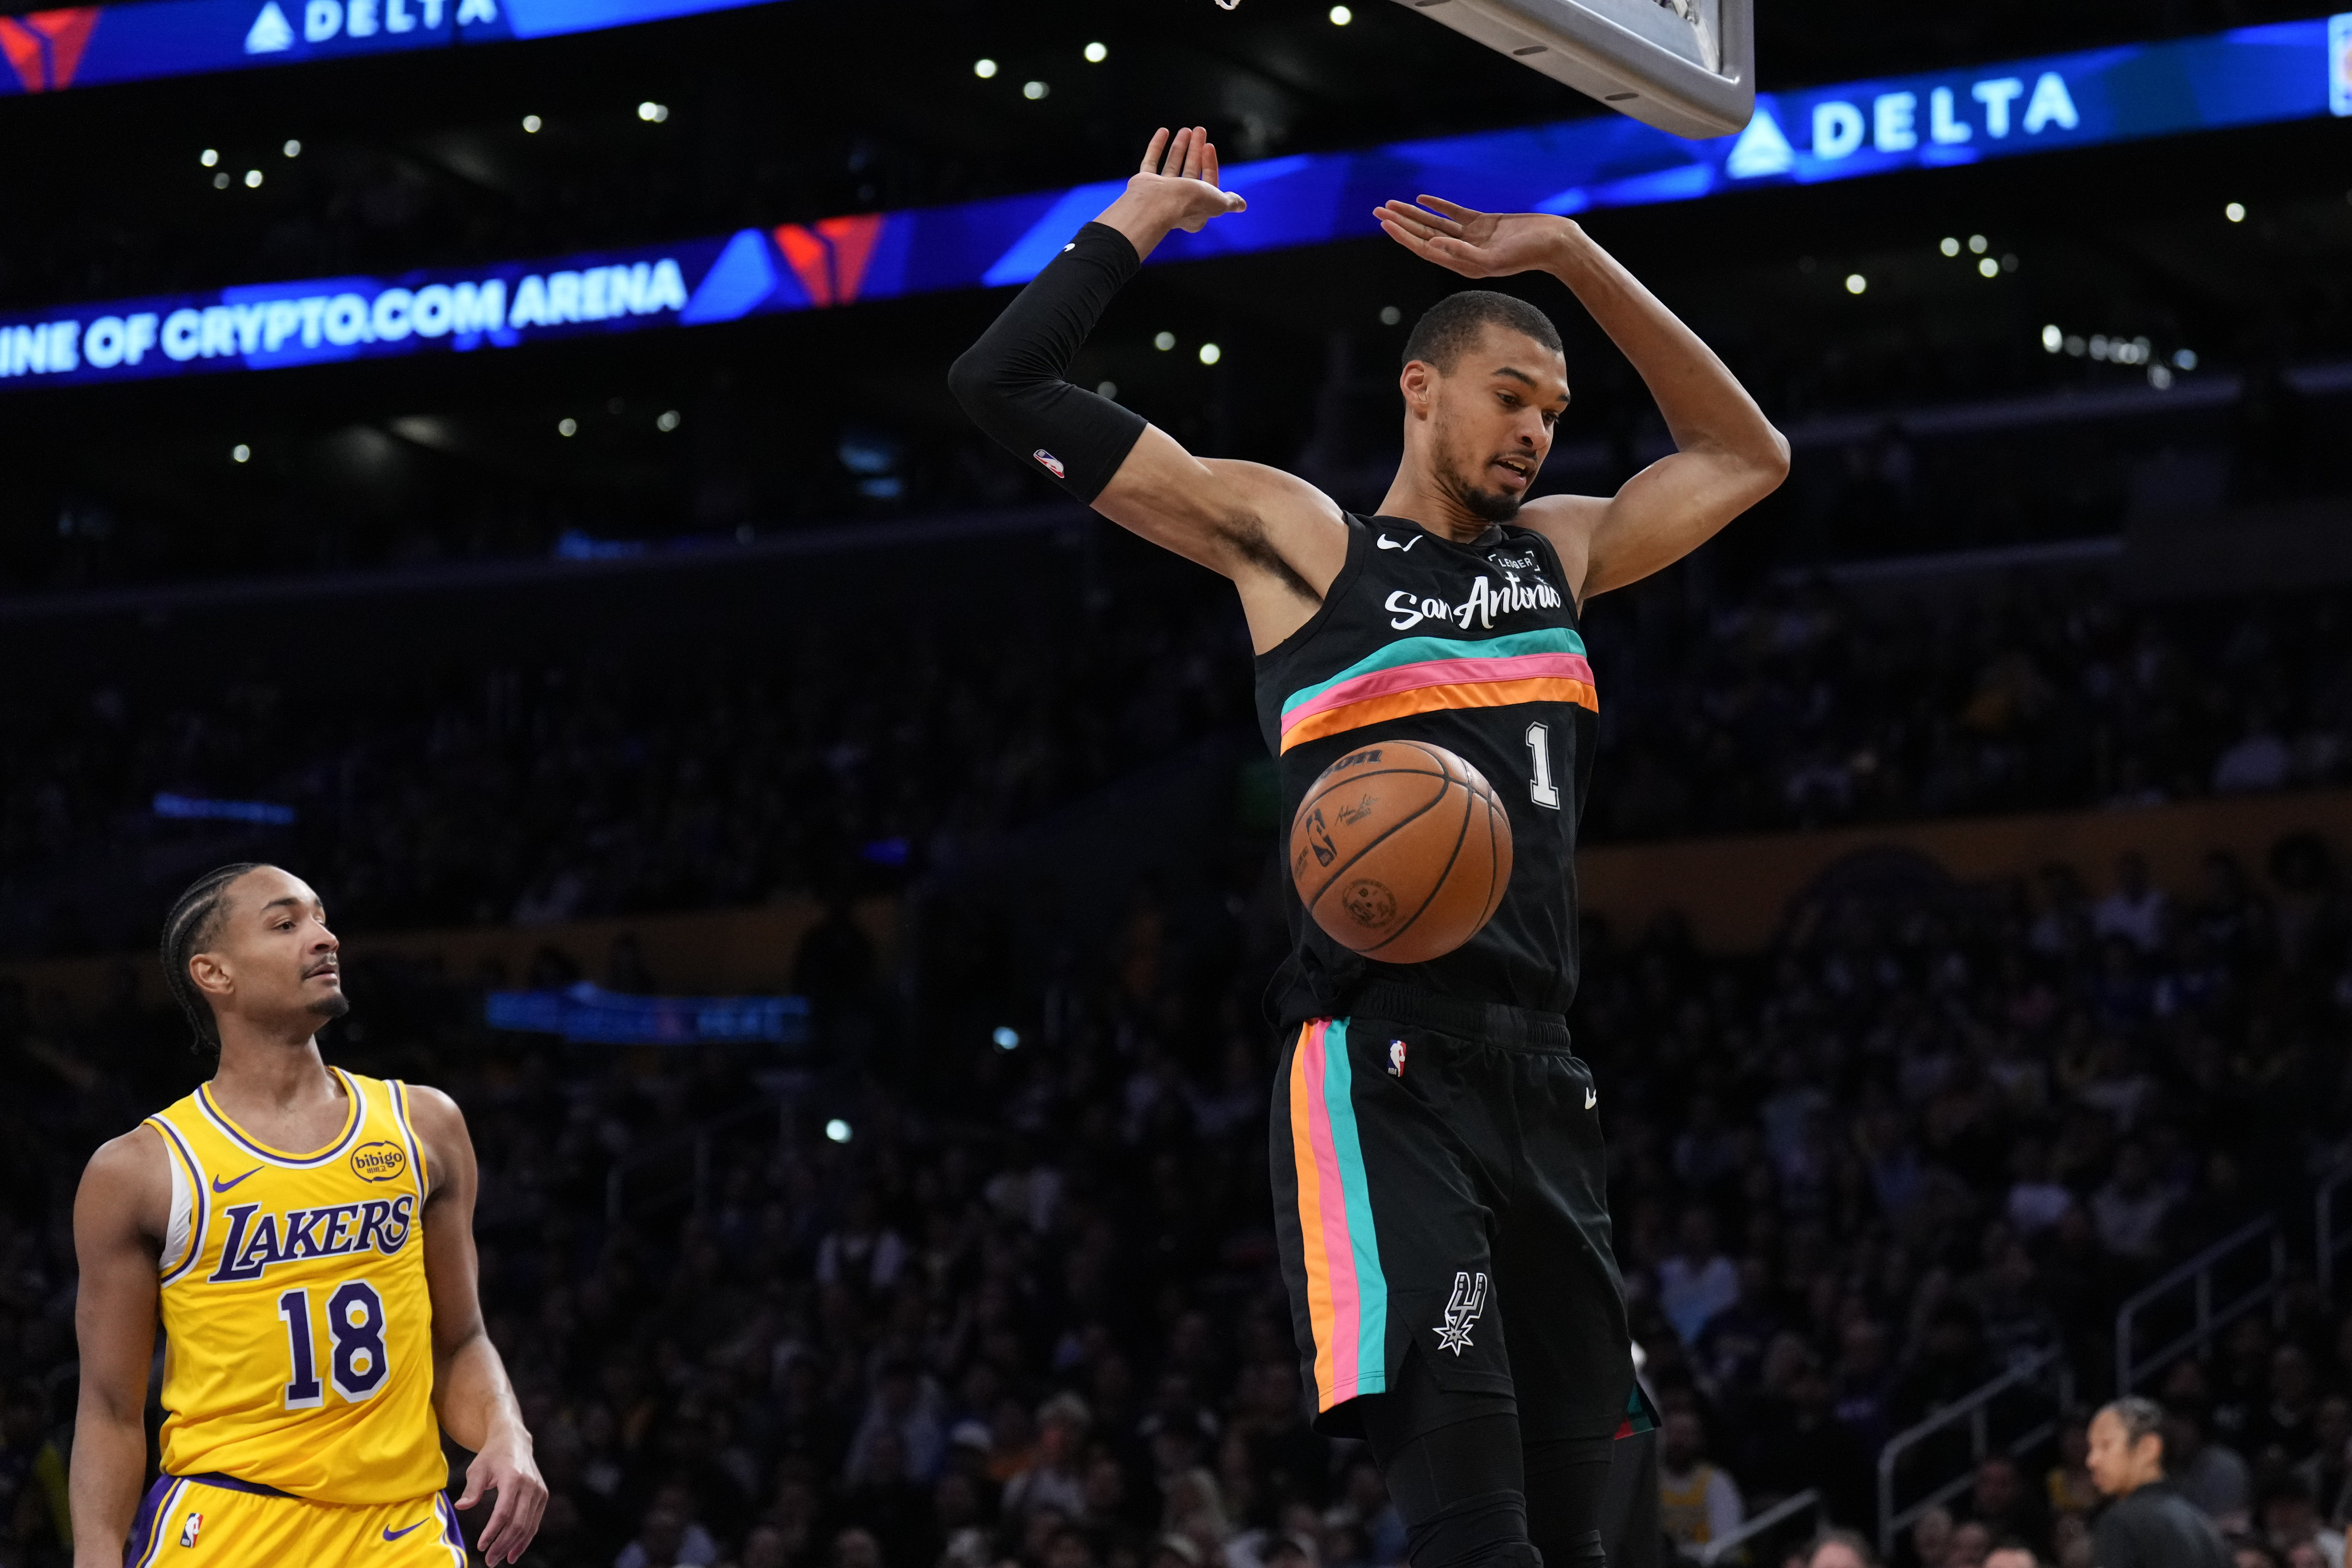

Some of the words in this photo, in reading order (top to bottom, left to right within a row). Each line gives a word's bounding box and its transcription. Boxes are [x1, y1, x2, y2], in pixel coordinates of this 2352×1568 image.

[304, 0, 498, 42] DELTA
[1812, 72, 2080, 160] DELTA
[84, 313, 158, 368] OF
[161, 278, 506, 361] CRYPTO.COM
[509, 258, 688, 329] ARENA
[1385, 590, 1453, 630] San
[1453, 571, 1561, 629] Antonio
[1498, 558, 1533, 569] LEDGER
[1525, 721, 1560, 810] 1
[355, 1152, 402, 1168] bibigo
[207, 1194, 414, 1284] LAKERS
[277, 1278, 389, 1411] 18
